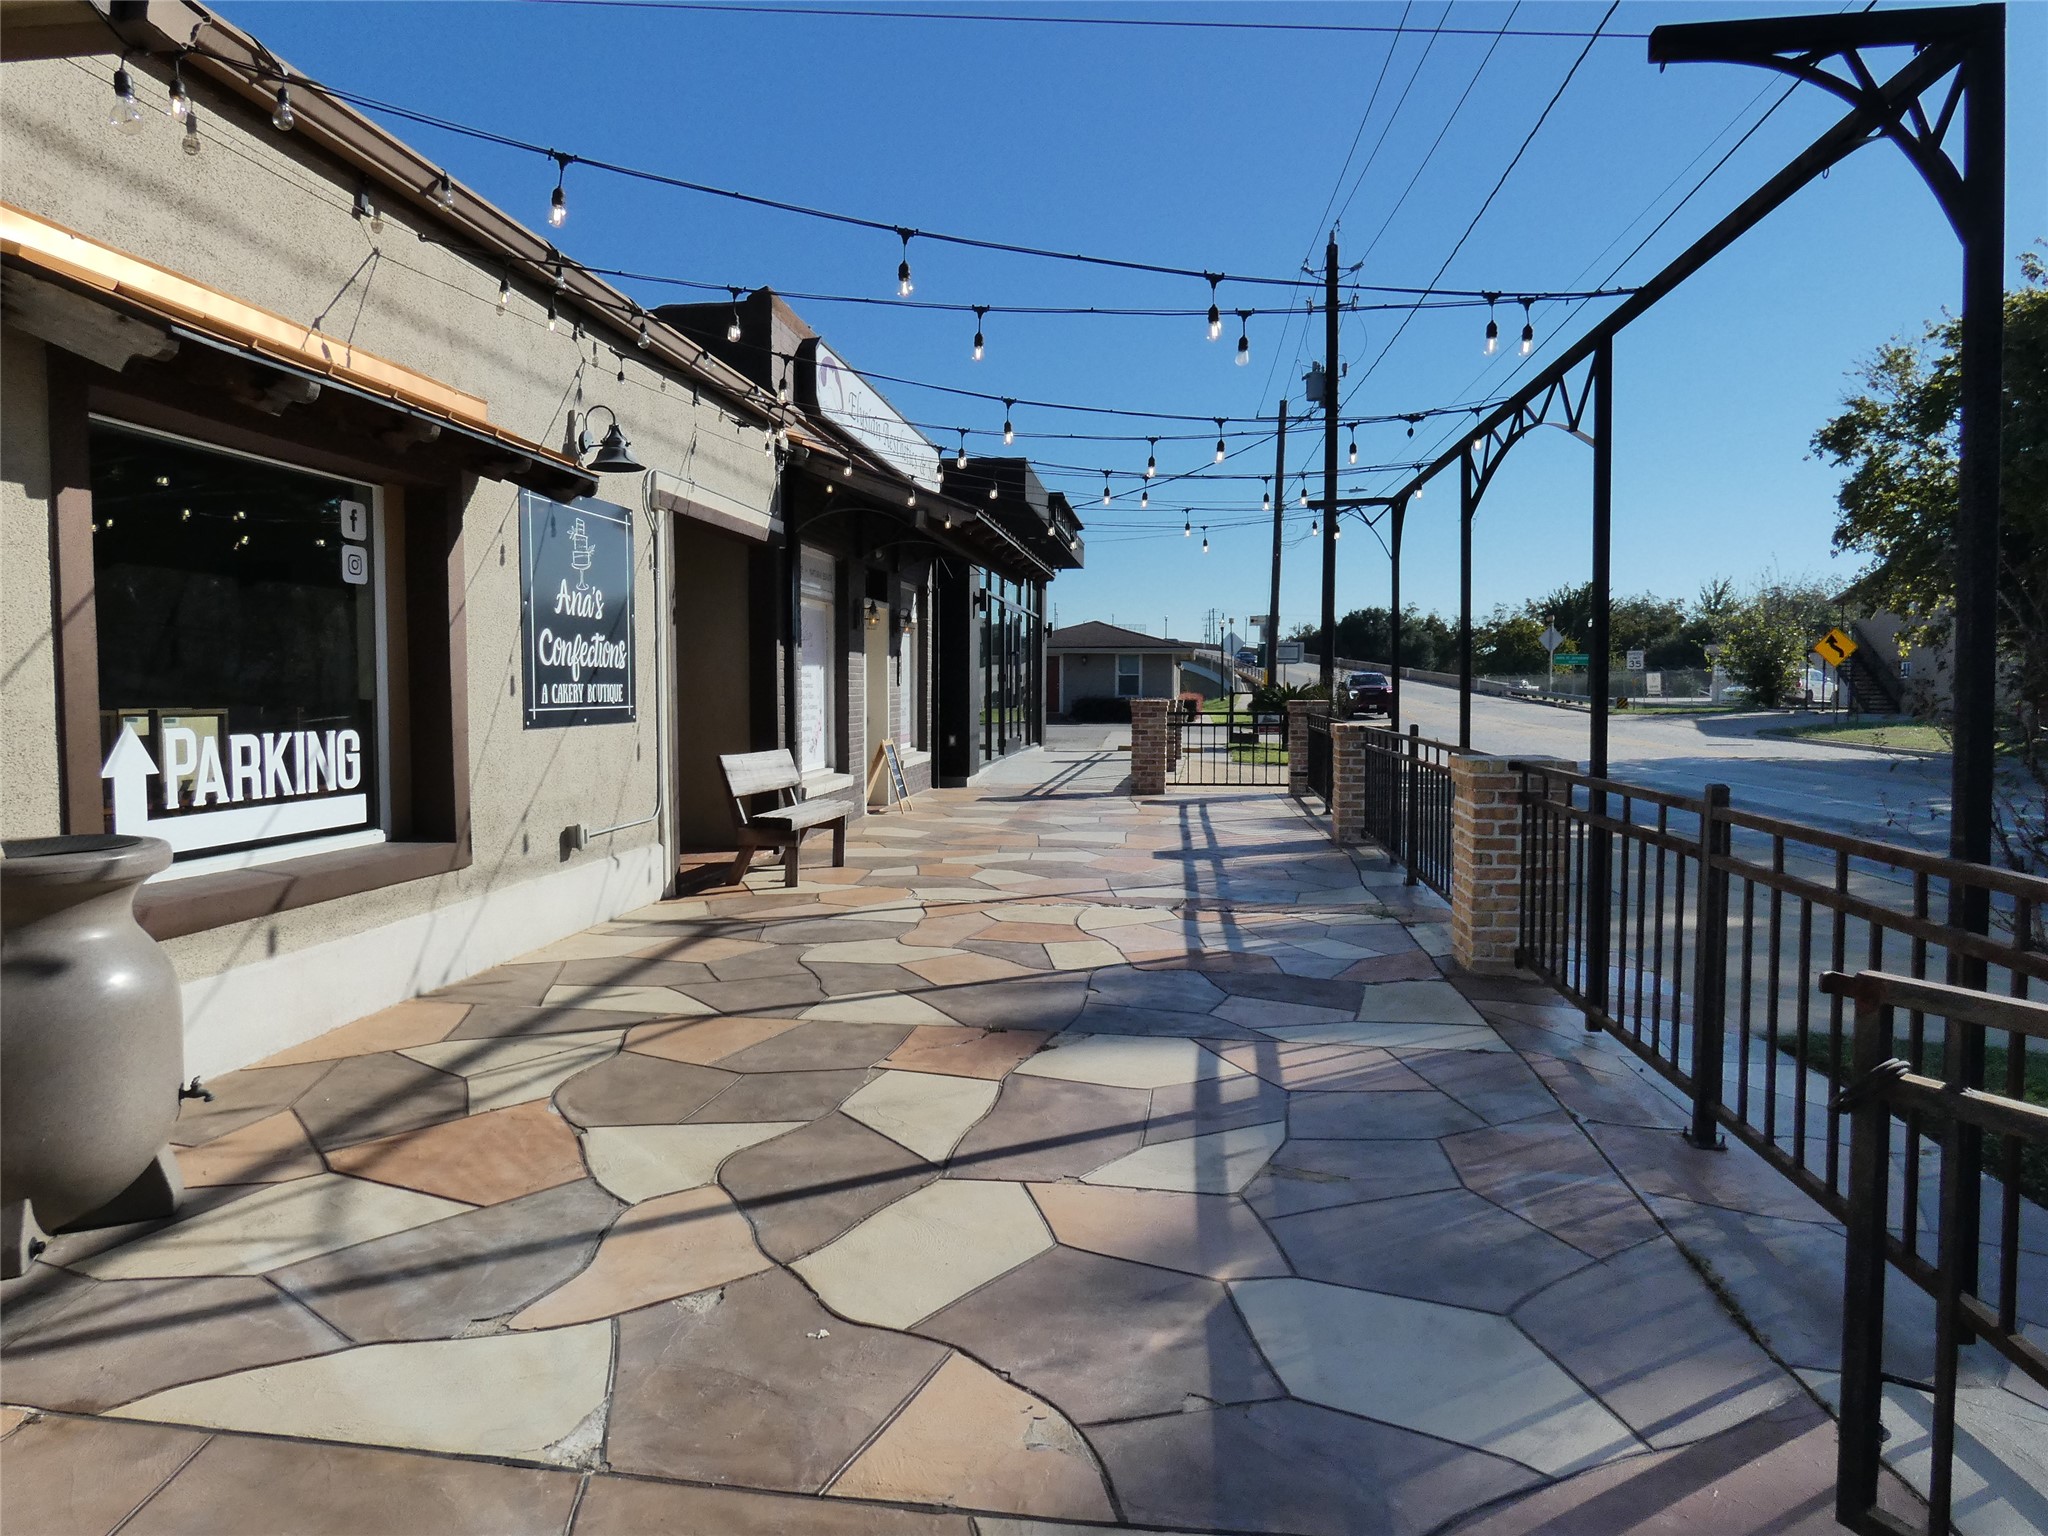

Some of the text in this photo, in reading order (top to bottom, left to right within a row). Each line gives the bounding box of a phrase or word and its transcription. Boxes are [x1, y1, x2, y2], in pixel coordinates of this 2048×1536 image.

[554, 578, 605, 620] Ana's
[538, 628, 628, 682] Confections
[1628, 660, 1642, 668] 35
[541, 683, 624, 705] A CAKERY BOUTIQUE
[163, 727, 361, 810] PARKING
